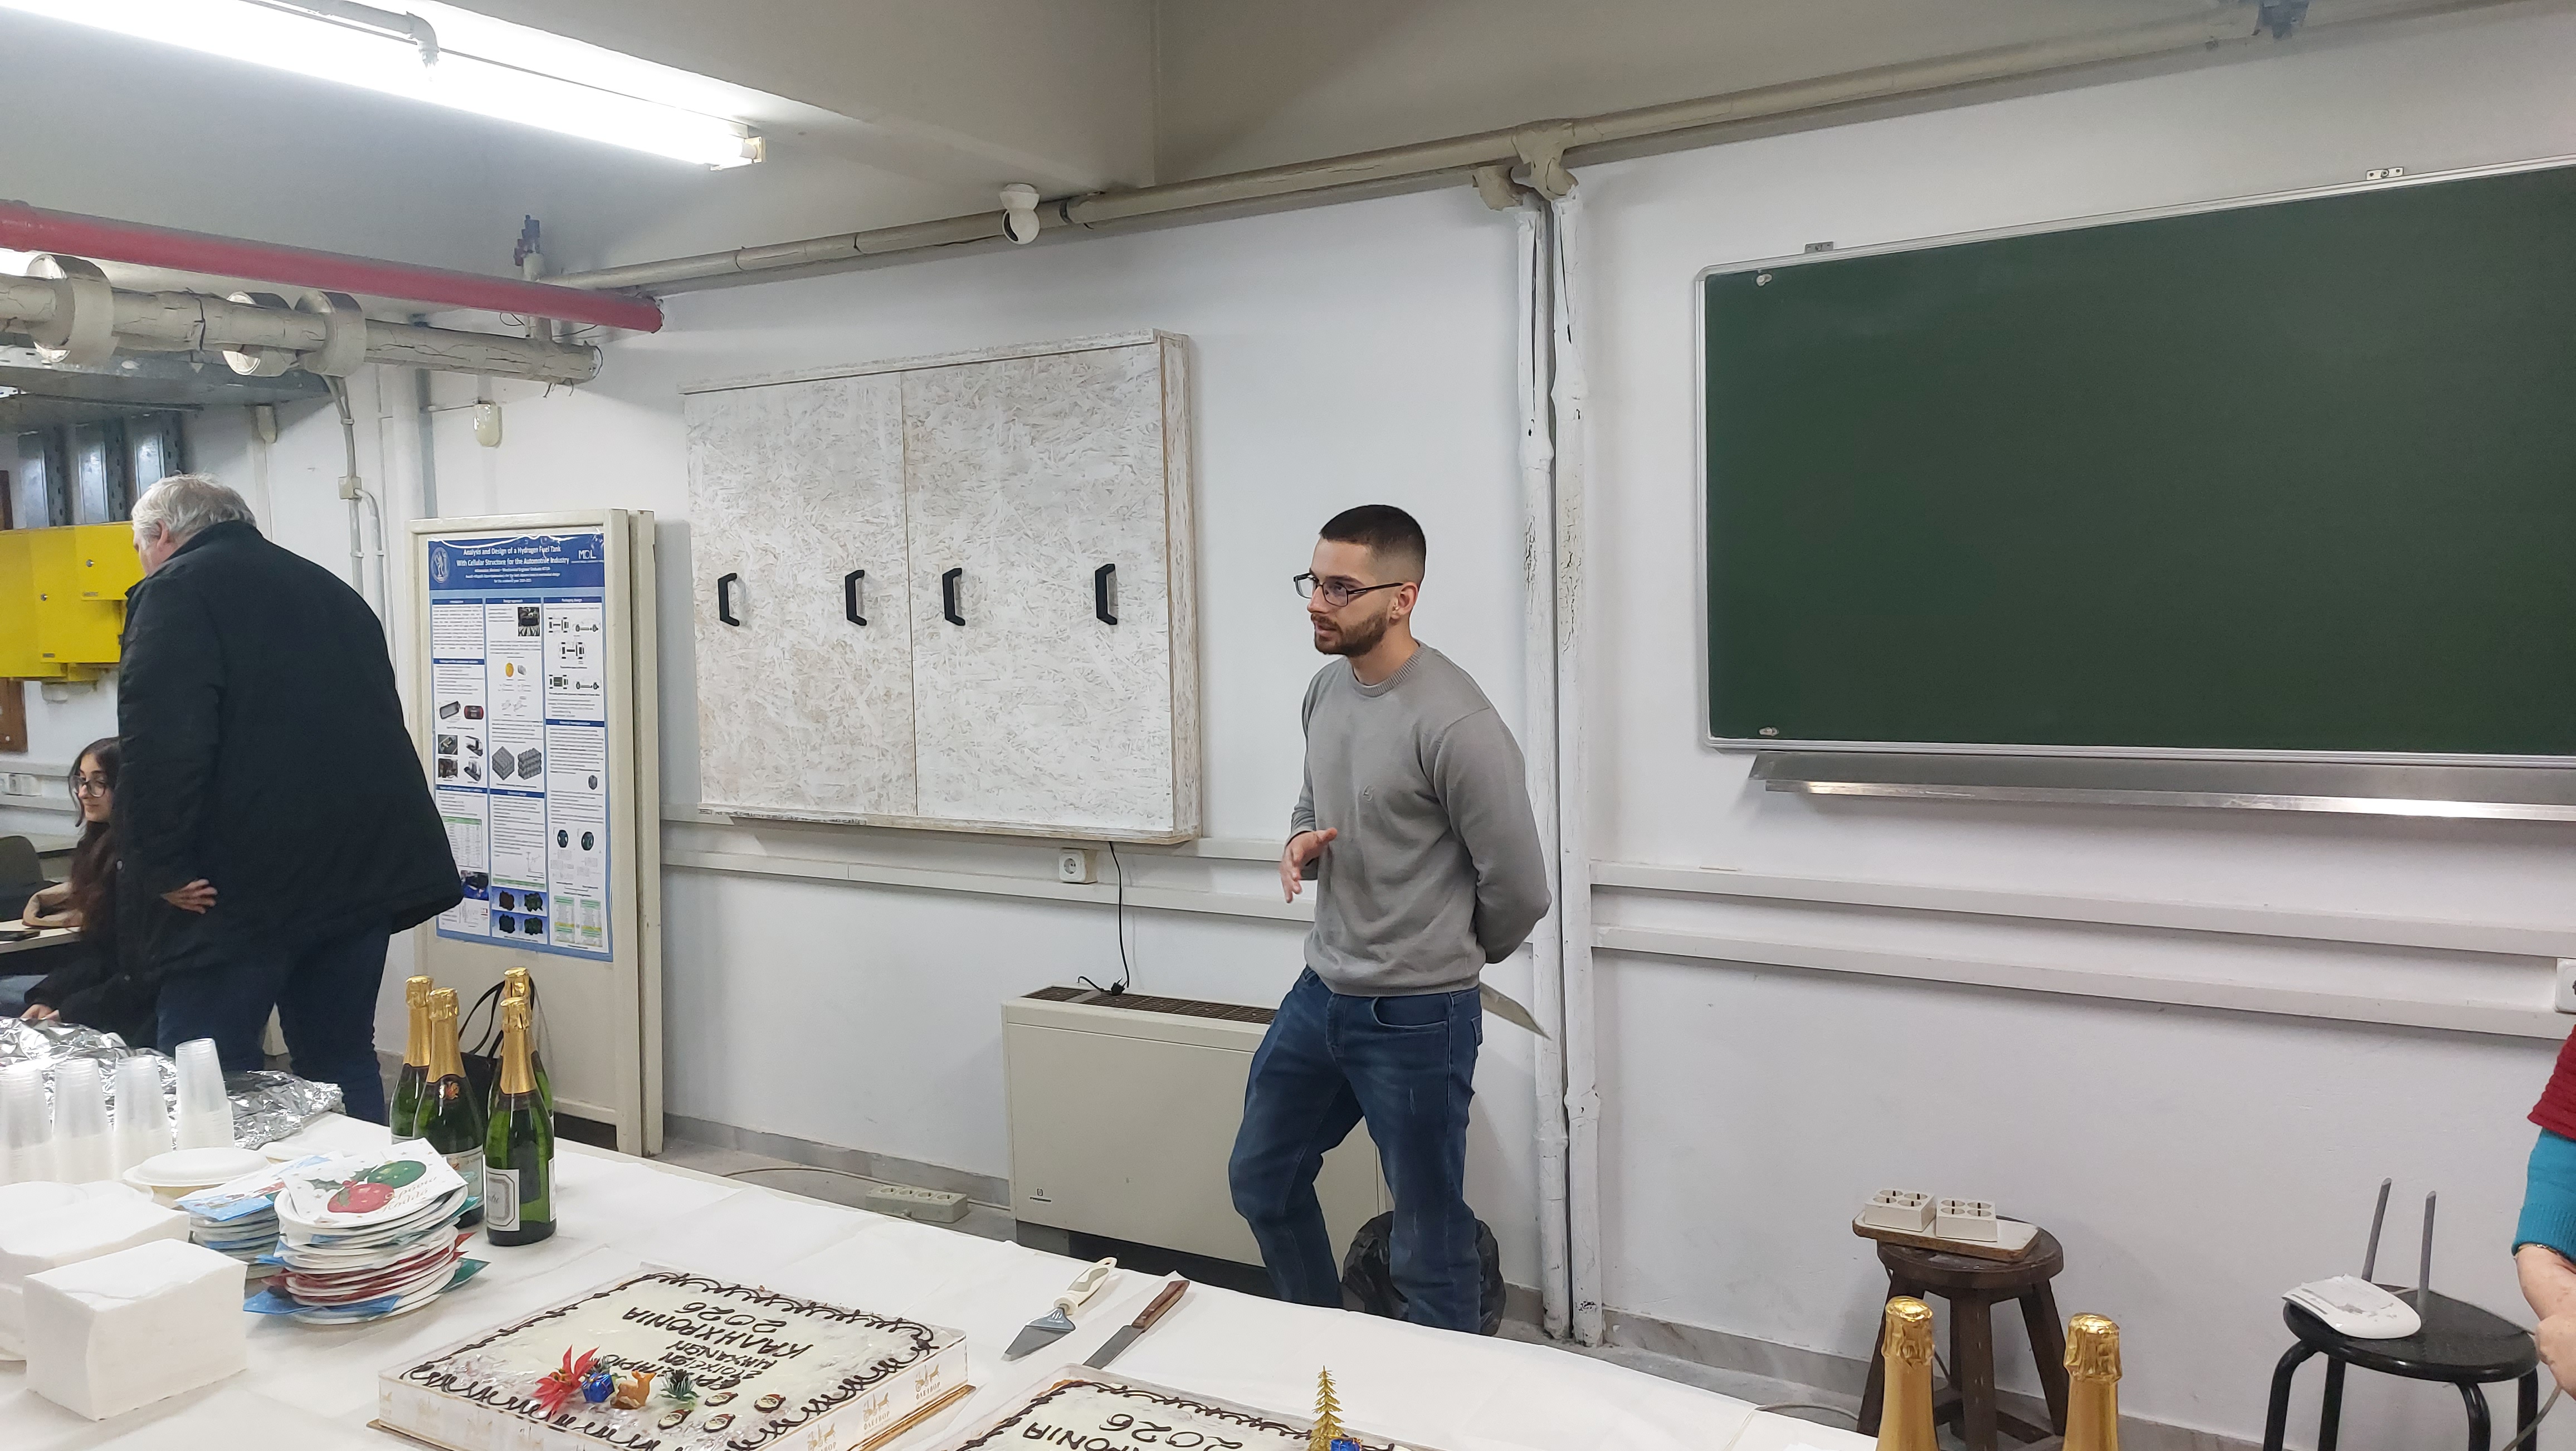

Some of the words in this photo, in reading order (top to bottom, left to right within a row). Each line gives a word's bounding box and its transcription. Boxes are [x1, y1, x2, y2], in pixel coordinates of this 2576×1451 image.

[464, 548, 481, 557] Analysis
[491, 547, 506, 556] Design
[518, 547, 538, 555] Hydrogen
[550, 556, 569, 564] Industry
[674, 1302, 787, 1333] 2026
